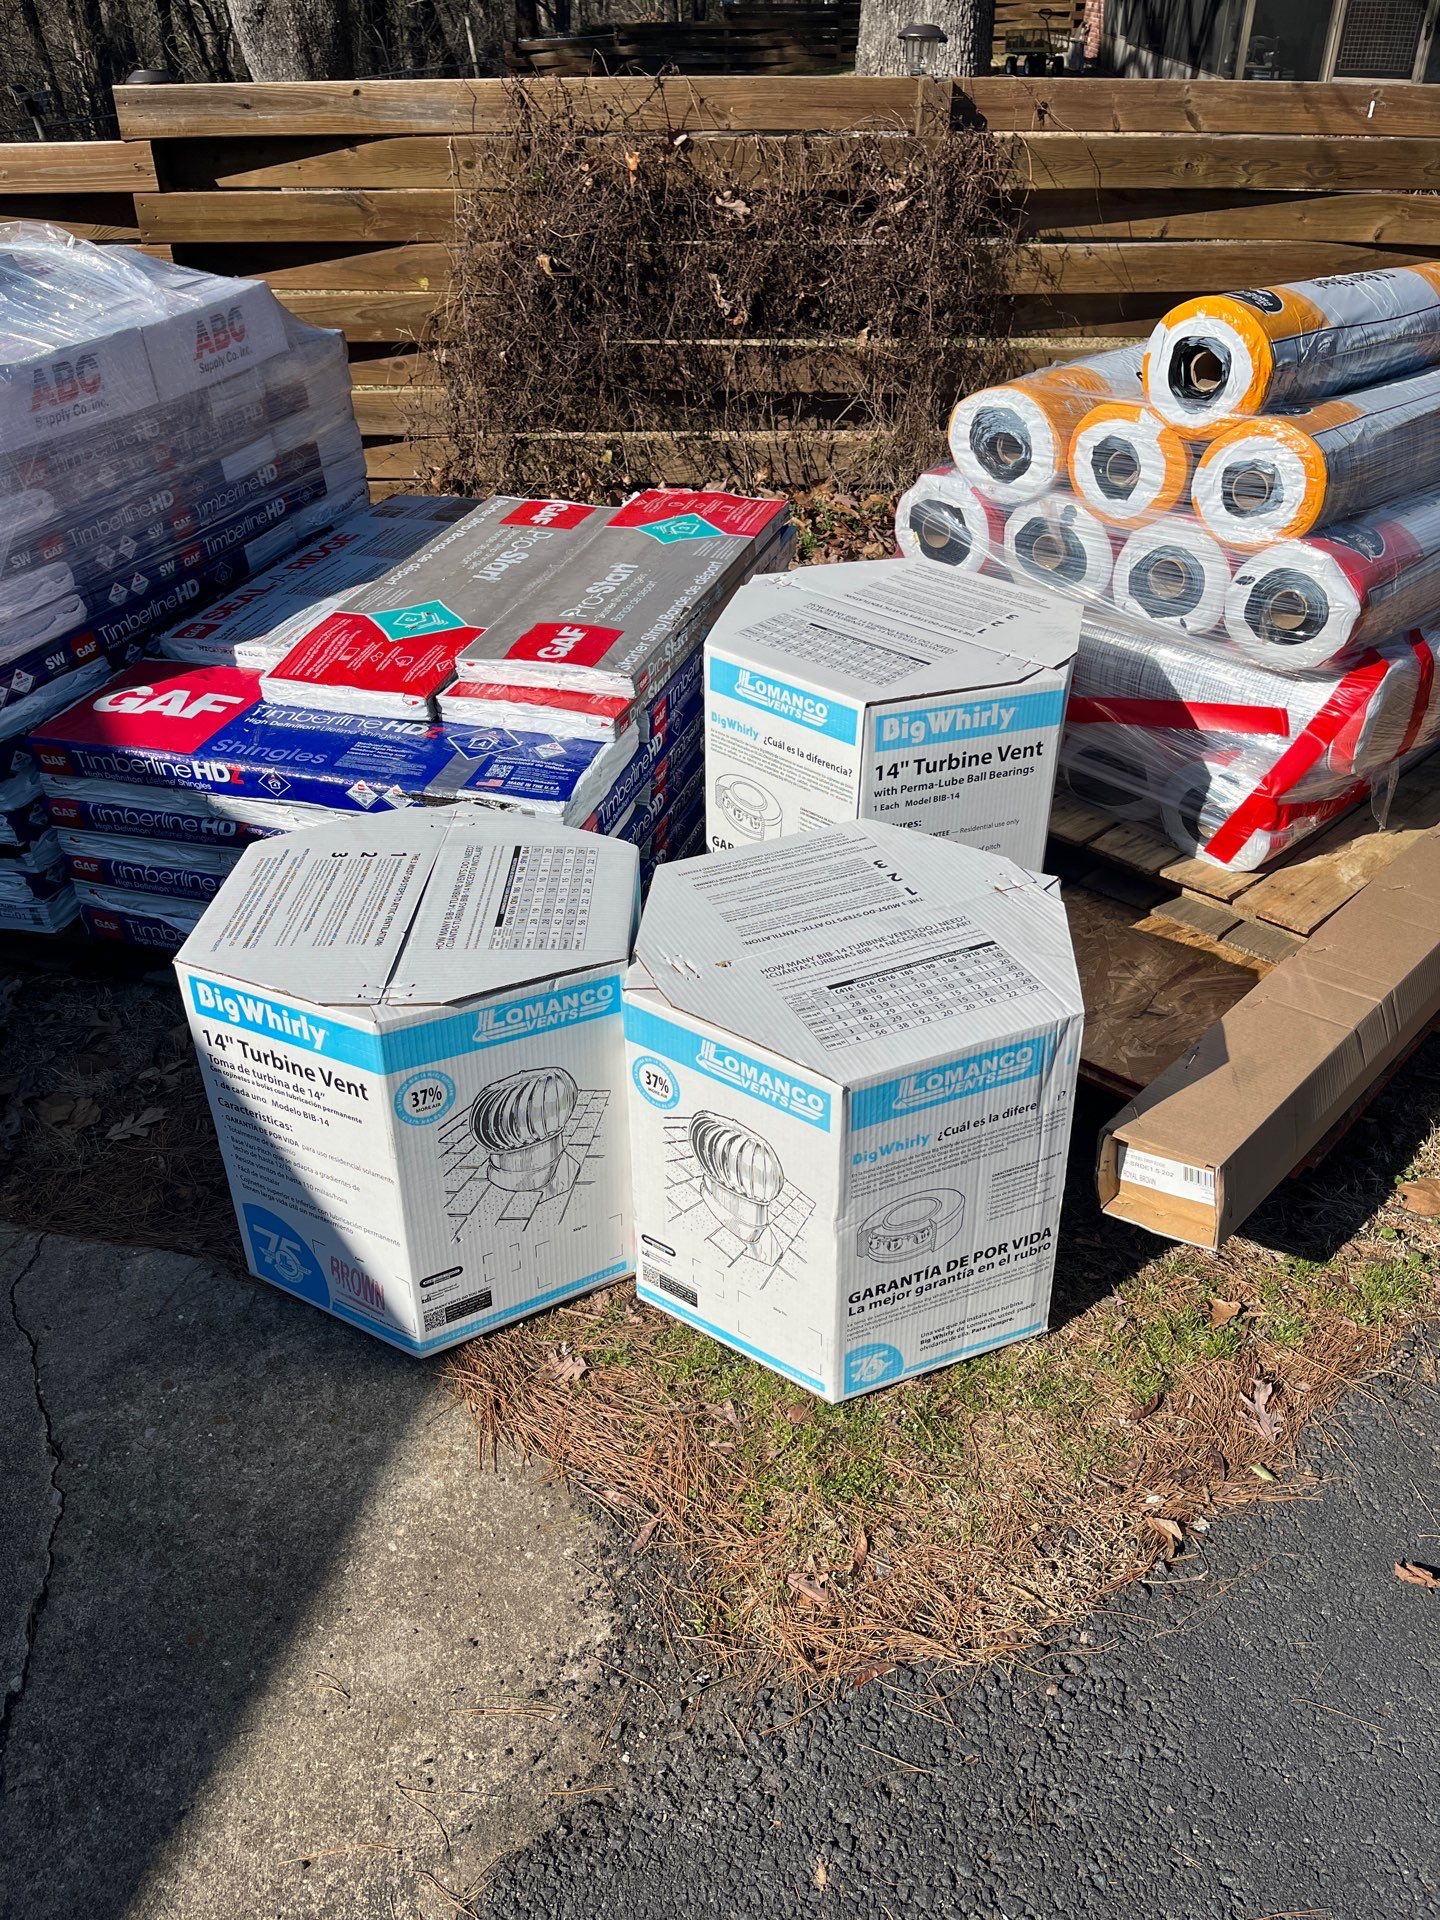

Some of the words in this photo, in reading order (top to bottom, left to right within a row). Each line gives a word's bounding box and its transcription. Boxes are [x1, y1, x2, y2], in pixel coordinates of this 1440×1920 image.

[193, 305, 246, 362] ABC
[199, 356, 225, 374] Supply
[31, 352, 104, 412] ABC
[35, 408, 71, 429] Supply
[147, 522, 164, 539] SW
[173, 516, 191, 531] GAF
[530, 503, 569, 526] GAF
[11, 551, 32, 569] SW
[43, 543, 65, 560] GAF
[159, 559, 177, 577] SW
[183, 552, 201, 567] GAF
[559, 561, 640, 618] Pro-Start
[614, 641, 651, 671] Starter
[685, 583, 701, 599] de
[694, 560, 723, 587] départ
[184, 625, 205, 638] GAF
[537, 625, 589, 659] GAF
[45, 651, 66, 670] SW
[76, 641, 97, 658] GAF
[93, 686, 245, 719] GAF
[742, 669, 829, 718] LOMANCO
[244, 716, 268, 725] High
[653, 705, 667, 727] GAF
[767, 699, 803, 719] VENTS
[40, 754, 67, 767] GAF
[211, 738, 328, 764] Shingles
[763, 736, 786, 751] ¿Cuál
[786, 745, 796, 755] es
[797, 747, 805, 758] la
[807, 750, 853, 777] diferencia?
[875, 760, 909, 781] 14"
[913, 750, 992, 776] Turbine
[998, 741, 1044, 762] Vent
[874, 785, 898, 798] with
[900, 775, 965, 794] Perma-Lube
[967, 771, 987, 784] Ball
[989, 765, 1035, 780] Bearings
[51, 806, 79, 819] GAF
[880, 802, 900, 811] Each
[905, 796, 932, 808] Model
[933, 792, 960, 804] BIB-14
[960, 822, 994, 834] Residential
[1006, 818, 1020, 828] only
[985, 843, 1001, 852] pitch
[73, 860, 99, 873] GAF
[872, 859, 889, 870] 3
[886, 872, 903, 883] 2
[905, 885, 918, 896] 1
[94, 919, 118, 931] GAF
[760, 963, 785, 975] HOW
[786, 956, 815, 969] MANY
[816, 947, 848, 960] BIB-14
[847, 938, 885, 953] TURBINE
[886, 929, 918, 941] VENTS
[918, 925, 933, 933] DO
[938, 915, 967, 928] NEED?
[812, 951, 857, 968] TURBINAS
[857, 943, 885, 955] BIB-14
[885, 932, 927, 949] NECESITO
[927, 920, 972, 938] INSTALAR?
[835, 986, 854, 995] C416
[485, 984, 613, 1031] LOMANCO
[525, 1009, 579, 1031] VENTS
[898, 1022, 909, 1030] 38
[920, 1016, 931, 1024] 22
[964, 1003, 976, 1011] 20
[985, 997, 997, 1005] 16
[1027, 984, 1039, 992] 39
[203, 1029, 233, 1052] 14"
[237, 1039, 316, 1082] Turbine
[318, 1066, 369, 1101] Vent
[207, 1053, 235, 1071] Toma
[237, 1061, 251, 1076] de
[252, 1066, 290, 1089] turbina
[292, 1081, 306, 1095] de
[307, 1085, 325, 1101] 14"
[701, 1039, 824, 1111] LOMANCO
[901, 1046, 1034, 1096] LOMANCO
[645, 1070, 669, 1095] 37%
[739, 1076, 789, 1107] VENTS
[943, 1072, 996, 1097] VENTS
[219, 1081, 230, 1092] de
[231, 1084, 251, 1099] cada
[251, 1093, 267, 1104] uno
[271, 1100, 301, 1117] Modelo
[303, 1111, 330, 1127] BIB-14
[411, 1085, 442, 1108] 37%
[415, 1105, 432, 1114] MORE
[432, 1102, 441, 1110] AIR
[937, 1121, 970, 1141] ¿Cuál
[973, 1118, 986, 1128] es
[988, 1113, 999, 1124] la
[283, 1136, 299, 1148] VIDA
[848, 1266, 942, 1304] GARANTÍA
[946, 1255, 969, 1273] DE
[973, 1243, 1008, 1264] POR
[1011, 1226, 1052, 1251] VIDA
[330, 1256, 386, 1311] BROWN
[848, 1306, 865, 1317] La
[869, 1290, 911, 1311] mejor
[915, 1269, 975, 1298] garantía
[978, 1262, 995, 1274] en
[998, 1256, 1011, 1268] el
[1014, 1241, 1051, 1262] rubro
